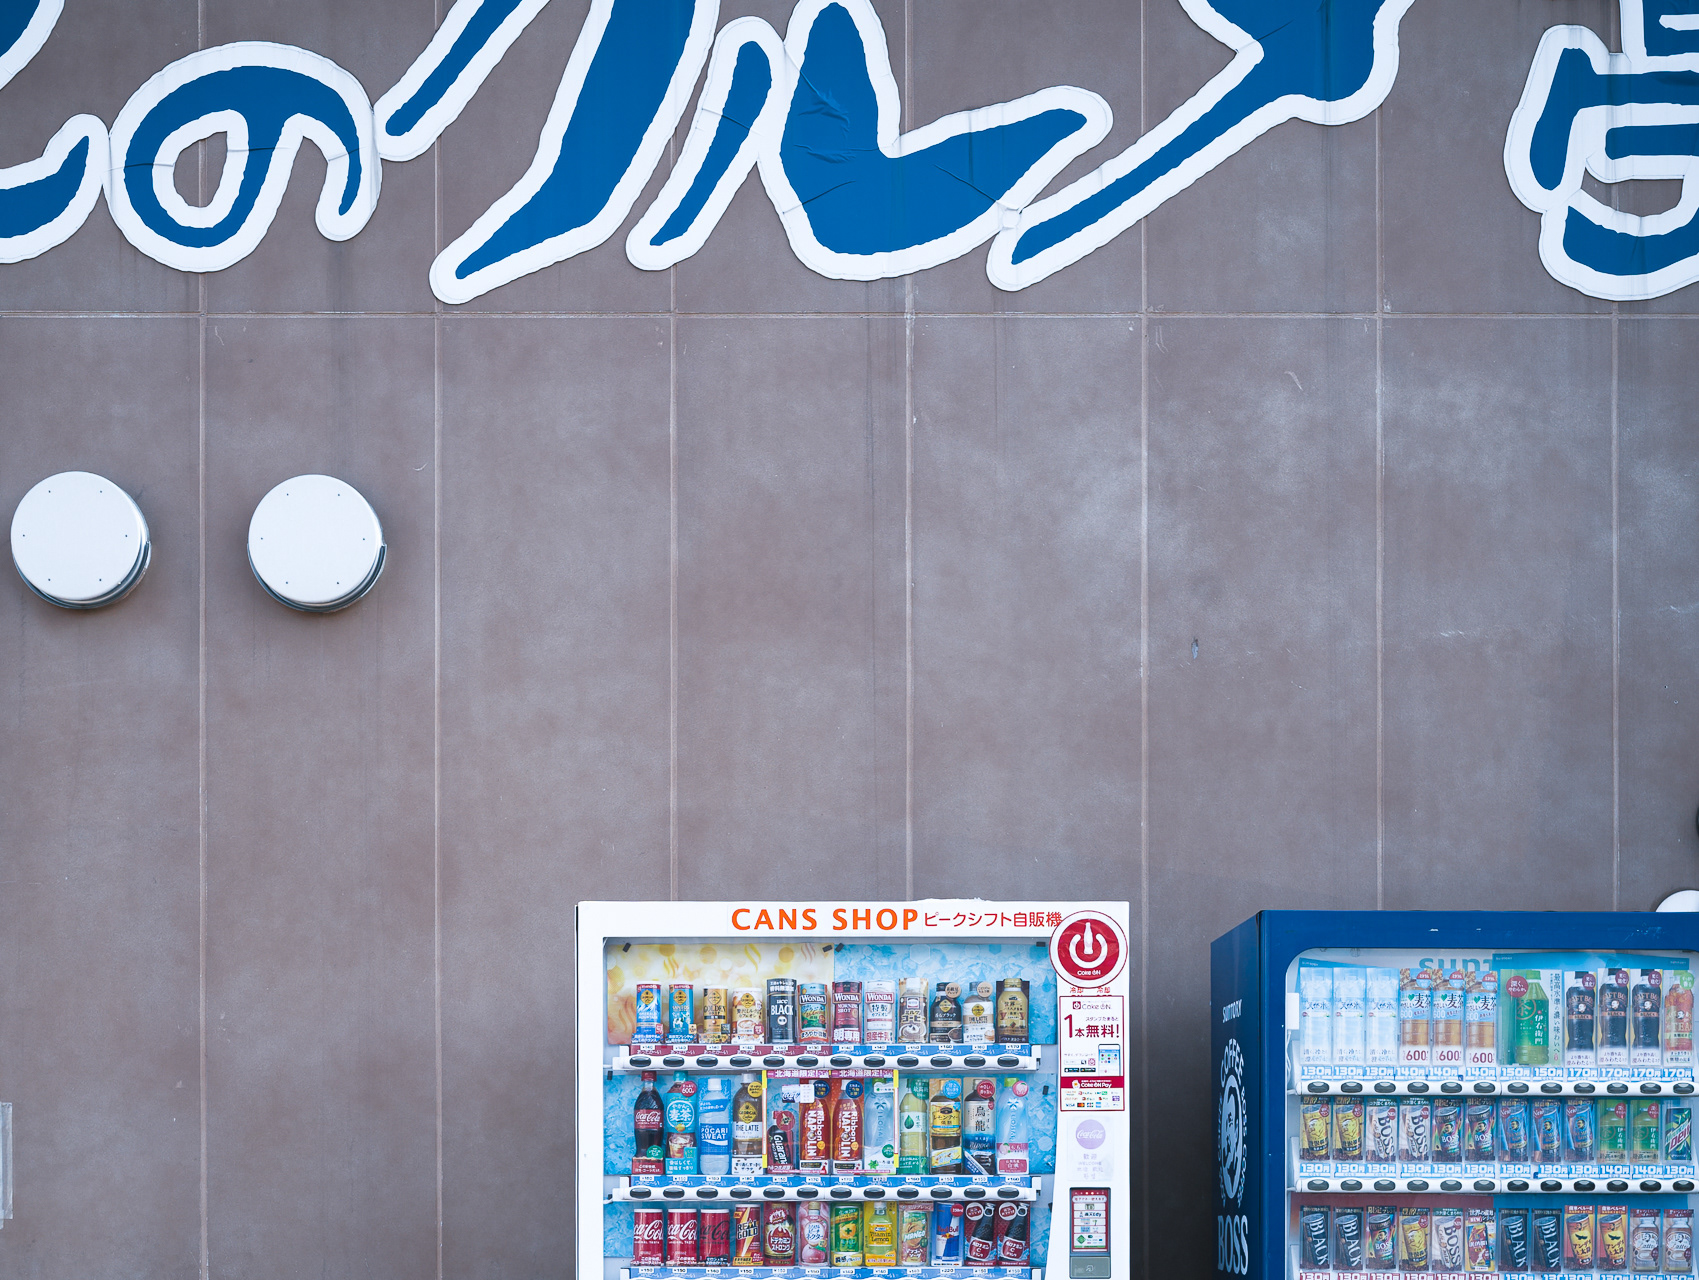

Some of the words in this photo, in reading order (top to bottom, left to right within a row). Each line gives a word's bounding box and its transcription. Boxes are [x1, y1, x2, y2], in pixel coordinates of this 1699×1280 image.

[731, 908, 817, 930] CANS
[832, 908, 918, 930] SHOP
[924, 911, 1062, 928] ピークシフト自販機
[800, 995, 825, 1003] WONDA
[835, 993, 859, 1001] WONDA
[867, 993, 892, 1001] WONDA
[771, 1004, 793, 1016] BLACK
[871, 1004, 888, 1012] 特製
[1223, 999, 1242, 1023] SUNTORY
[1535, 1015, 1543, 1044] 伊右衛門
[1672, 1022, 1692, 1032] TEA
[1221, 1039, 1244, 1088] COFFEE
[775, 1070, 819, 1078] 北海道限定!
[840, 1070, 882, 1078] 北海道限定!
[1303, 1067, 1332, 1076] 130円
[1335, 1067, 1362, 1076] 130円
[1366, 1067, 1394, 1076] 130円
[1396, 1067, 1425, 1076] 140円
[1429, 1067, 1458, 1076] 140円
[1467, 1068, 1496, 1077] 140円
[1502, 1068, 1530, 1077] 150円
[1535, 1068, 1563, 1077] 150円
[1569, 1068, 1597, 1077] 170円
[1601, 1068, 1630, 1077] 170円
[1634, 1068, 1661, 1077] 170円
[1664, 1068, 1692, 1077] 170円
[635, 1111, 661, 1122] Coca-Cola
[669, 1109, 691, 1121] 麦茶
[975, 1105, 986, 1132] 烏龍
[736, 1124, 744, 1132] THE
[745, 1124, 759, 1132] LATTE
[816, 1110, 824, 1141] Ribbon
[850, 1111, 858, 1142] Ribbon
[807, 1110, 817, 1156] NAPOLIN
[840, 1111, 850, 1157] NAPOLIN
[1077, 1129, 1104, 1139] Coca-Cola
[1378, 1115, 1395, 1155] BOSS
[1411, 1115, 1428, 1156] BOSS
[1474, 1133, 1492, 1141] BOSS
[1441, 1134, 1459, 1142] BOSS
[1301, 1164, 1329, 1173] 130円
[1337, 1164, 1365, 1173] 130円
[1367, 1164, 1395, 1173] 130円
[1403, 1164, 1431, 1173] 130円
[1433, 1165, 1461, 1173] 130円
[1466, 1165, 1494, 1173] 130円
[1502, 1165, 1530, 1173] 130円
[1540, 1165, 1568, 1174] 130円
[1570, 1165, 1599, 1174] 130円
[1601, 1165, 1629, 1174] 140円
[1634, 1165, 1663, 1174] 140円
[1665, 1165, 1693, 1174] 130円
[737, 1219, 758, 1231] REAL
[737, 1229, 758, 1240] GOLD
[903, 1230, 925, 1241] MANGO
[1218, 1214, 1249, 1275] BOSS
[1309, 1219, 1329, 1265] BLACK
[1343, 1221, 1361, 1267] BLACK
[1375, 1242, 1393, 1250] BOSS
[1444, 1226, 1460, 1265] BOSS
[1508, 1221, 1527, 1268] BLACK
[1541, 1221, 1560, 1268] BLACK
